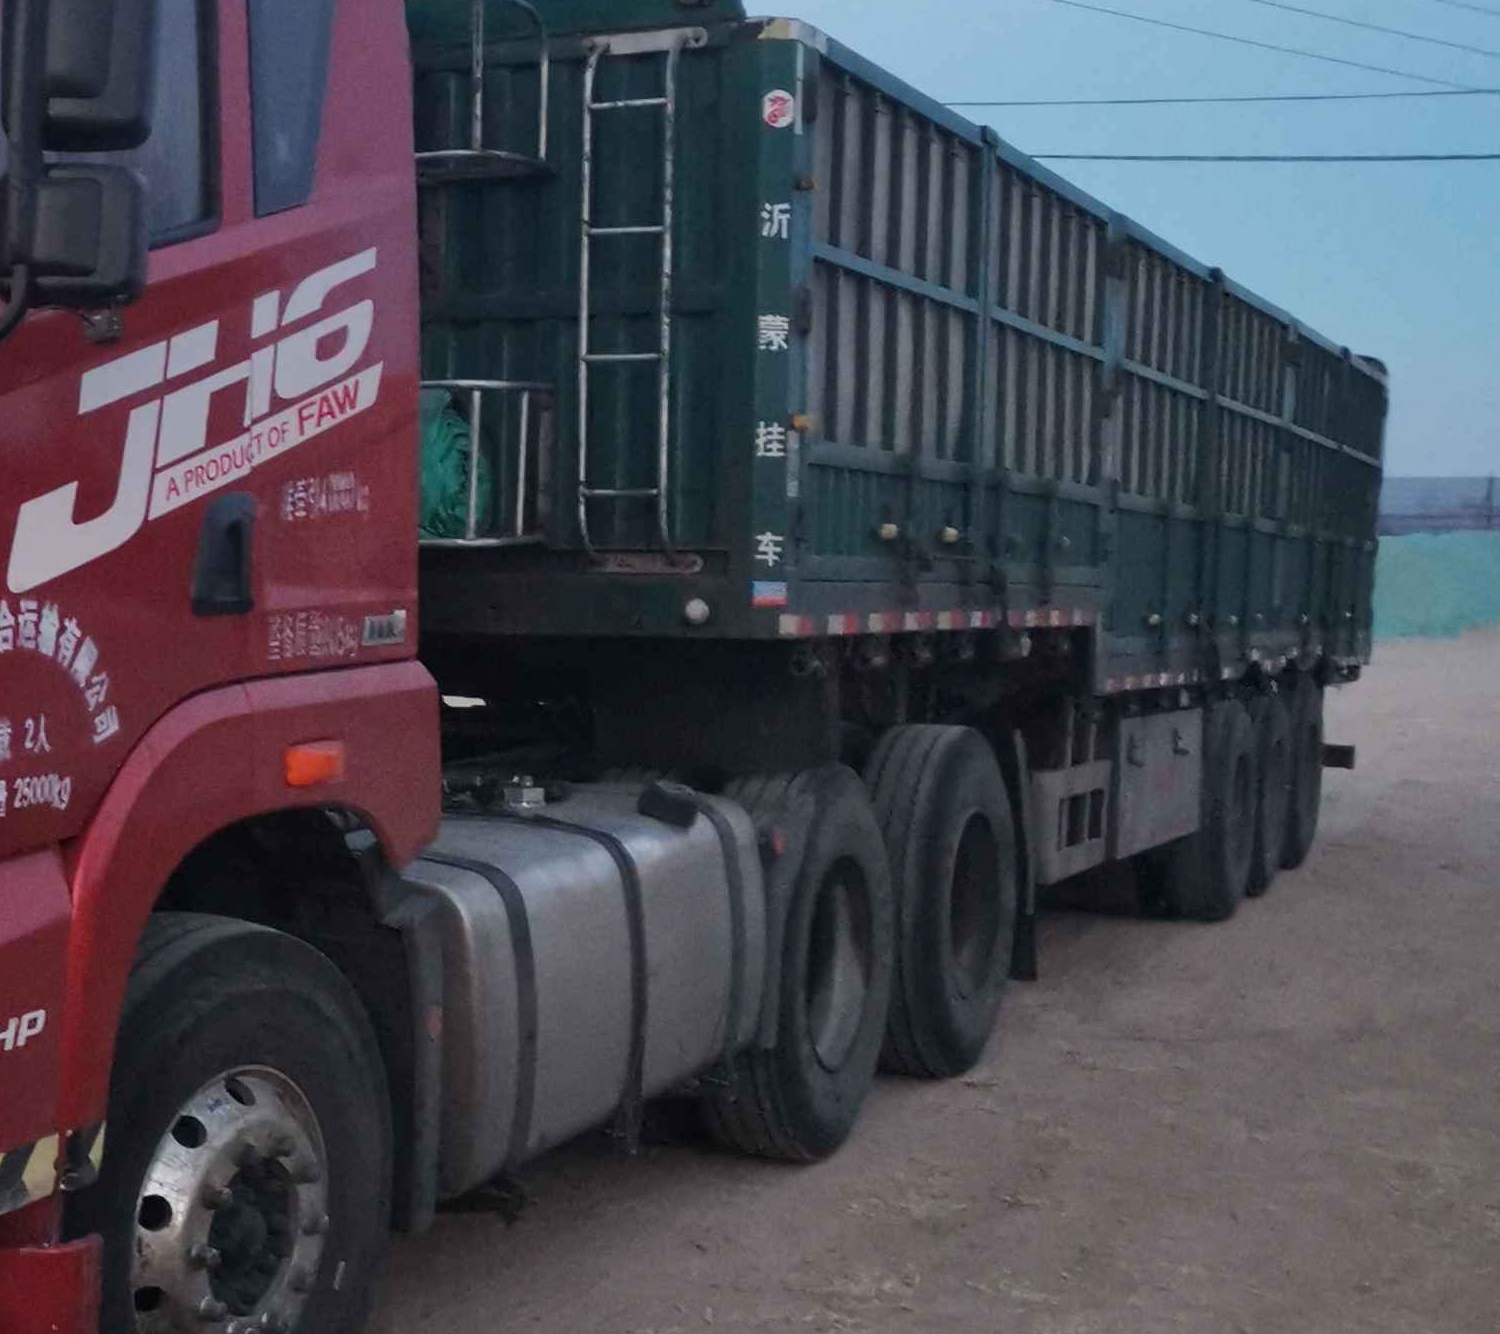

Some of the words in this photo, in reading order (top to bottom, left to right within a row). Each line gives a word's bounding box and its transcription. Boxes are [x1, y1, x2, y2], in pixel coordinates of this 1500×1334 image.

[6, 246, 377, 595] JH6
[165, 477, 181, 502] A
[183, 431, 264, 494] PRODUCT
[267, 421, 291, 449] OF
[296, 378, 361, 437] FAW
[753, 201, 792, 569] 沂蒙挂车
[23, 713, 52, 754] 2人
